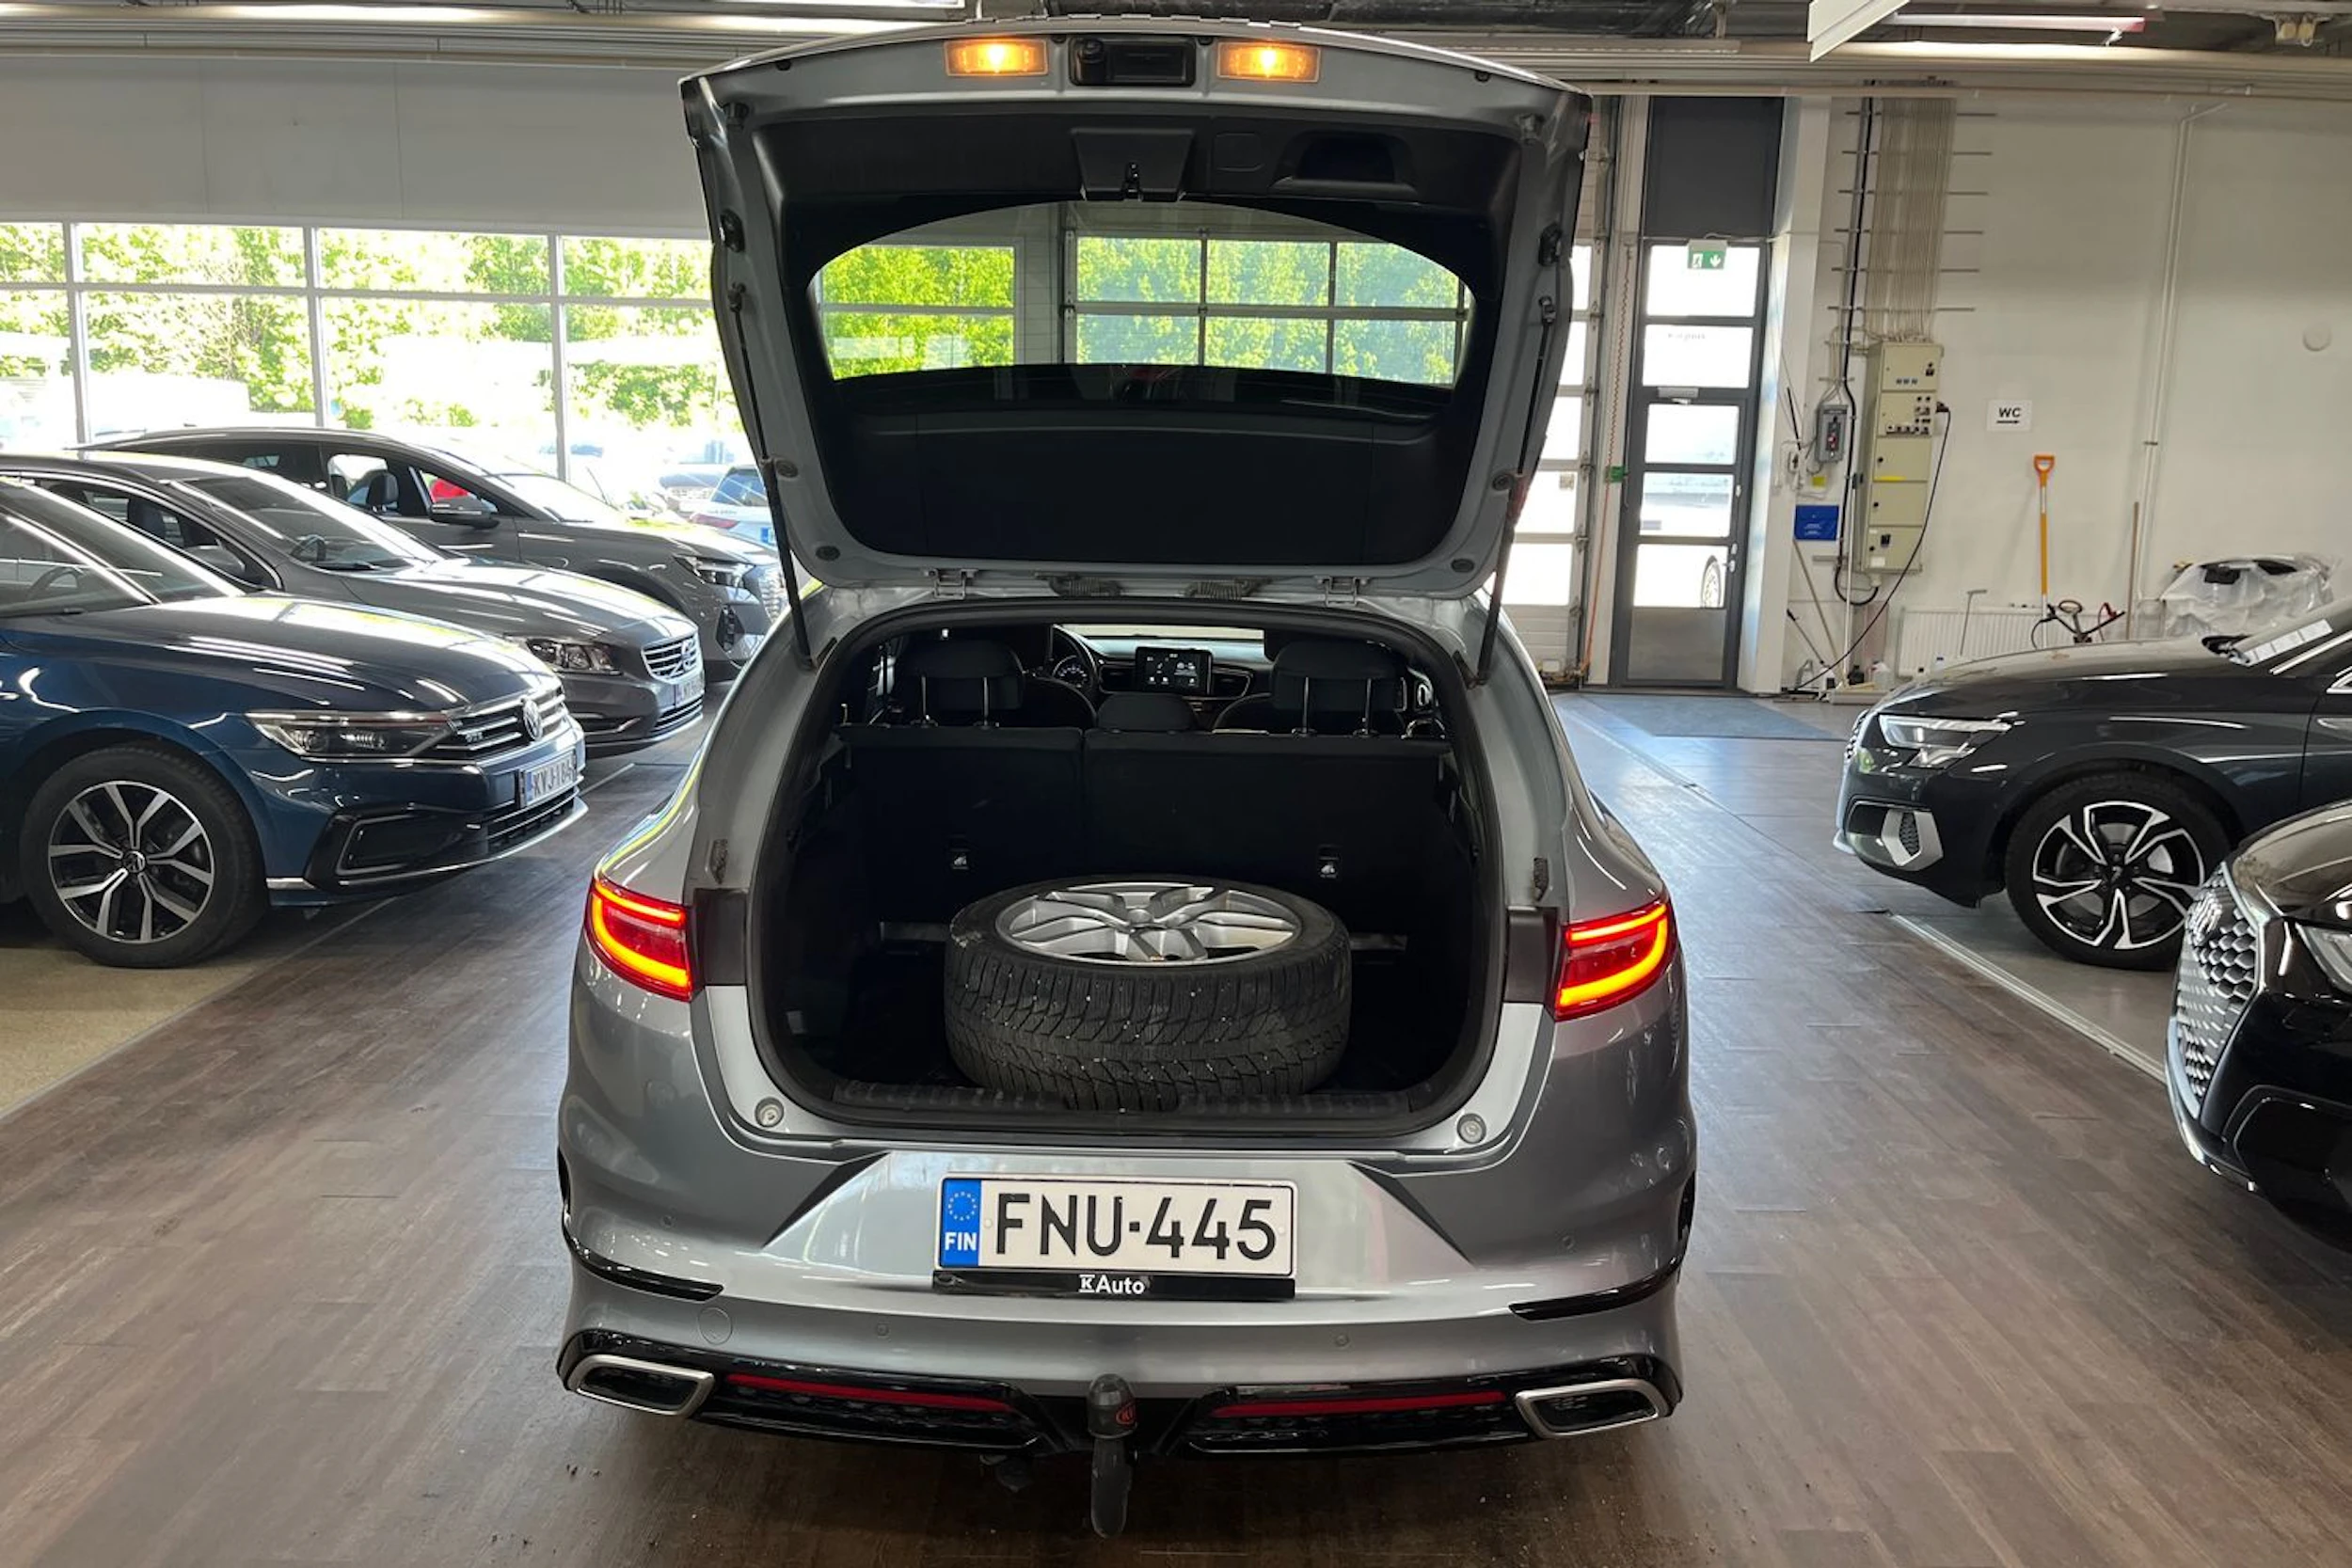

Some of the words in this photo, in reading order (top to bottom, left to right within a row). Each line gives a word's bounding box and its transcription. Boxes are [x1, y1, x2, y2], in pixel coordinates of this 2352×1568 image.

[1998, 407, 2022, 418] WC
[995, 1193, 1277, 1260] FNU-445
[945, 1231, 977, 1251] FIN
